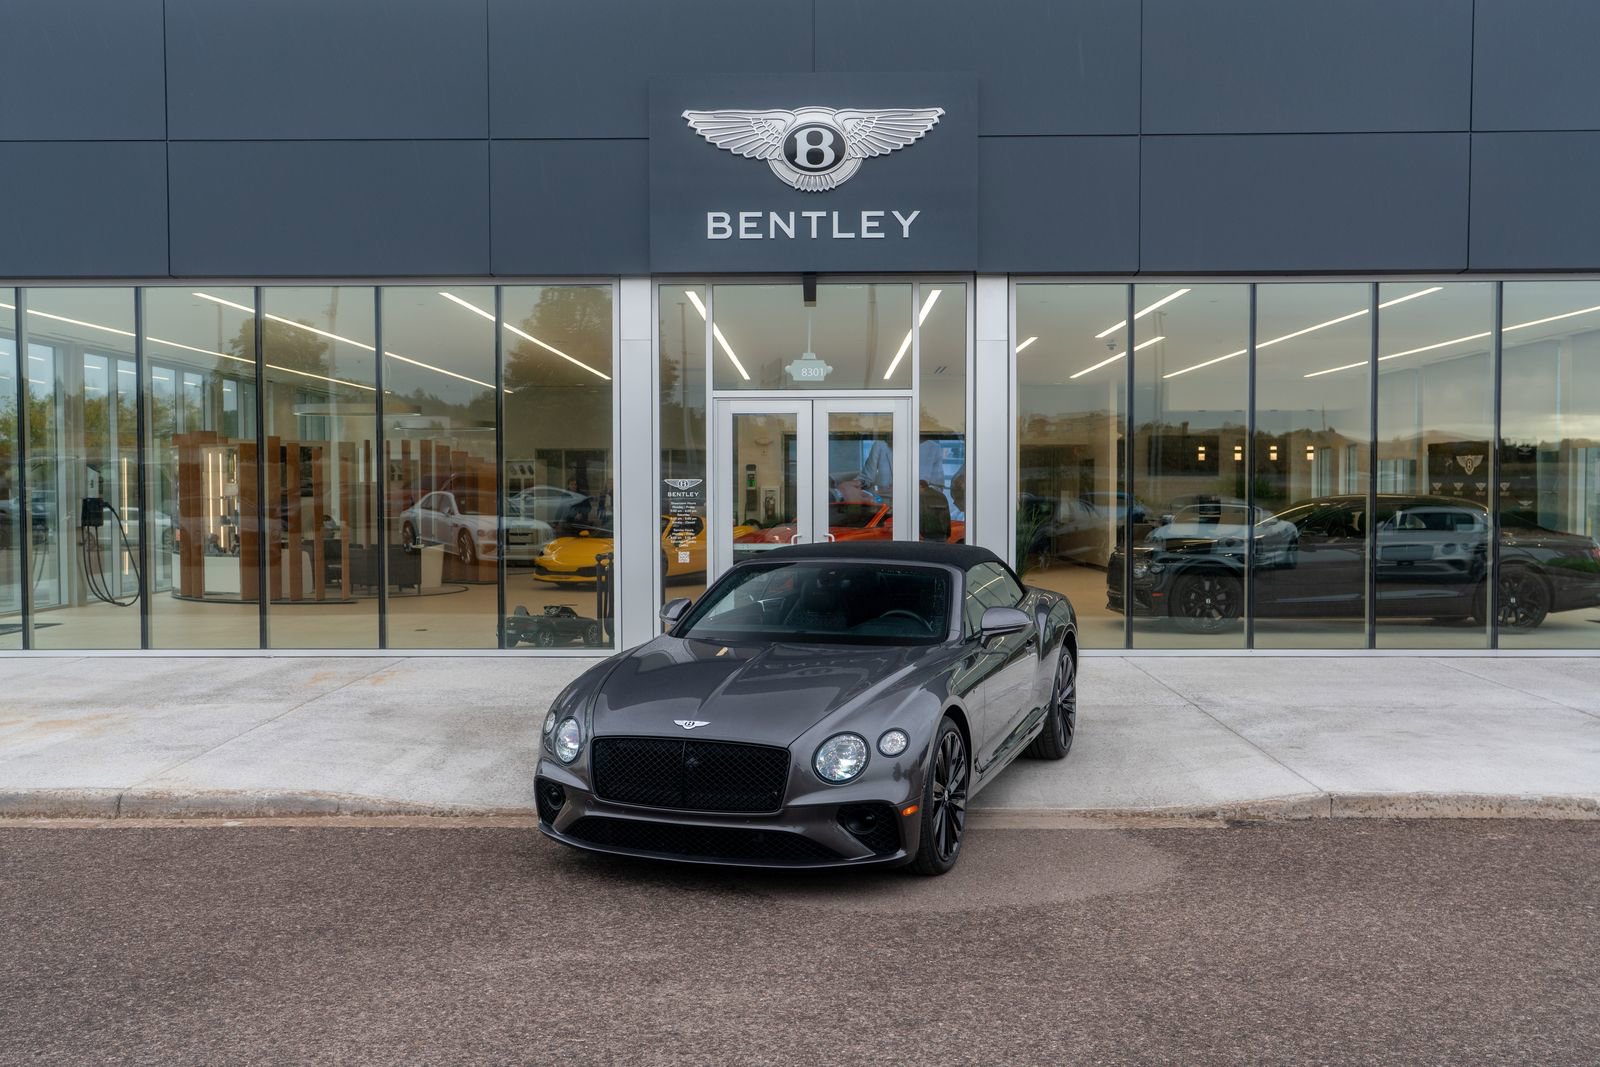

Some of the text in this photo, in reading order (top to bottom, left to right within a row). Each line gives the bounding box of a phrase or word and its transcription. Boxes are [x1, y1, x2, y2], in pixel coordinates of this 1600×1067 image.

[793, 127, 836, 168] B
[706, 210, 921, 240] BENTLEY
[801, 367, 824, 377] 8301
